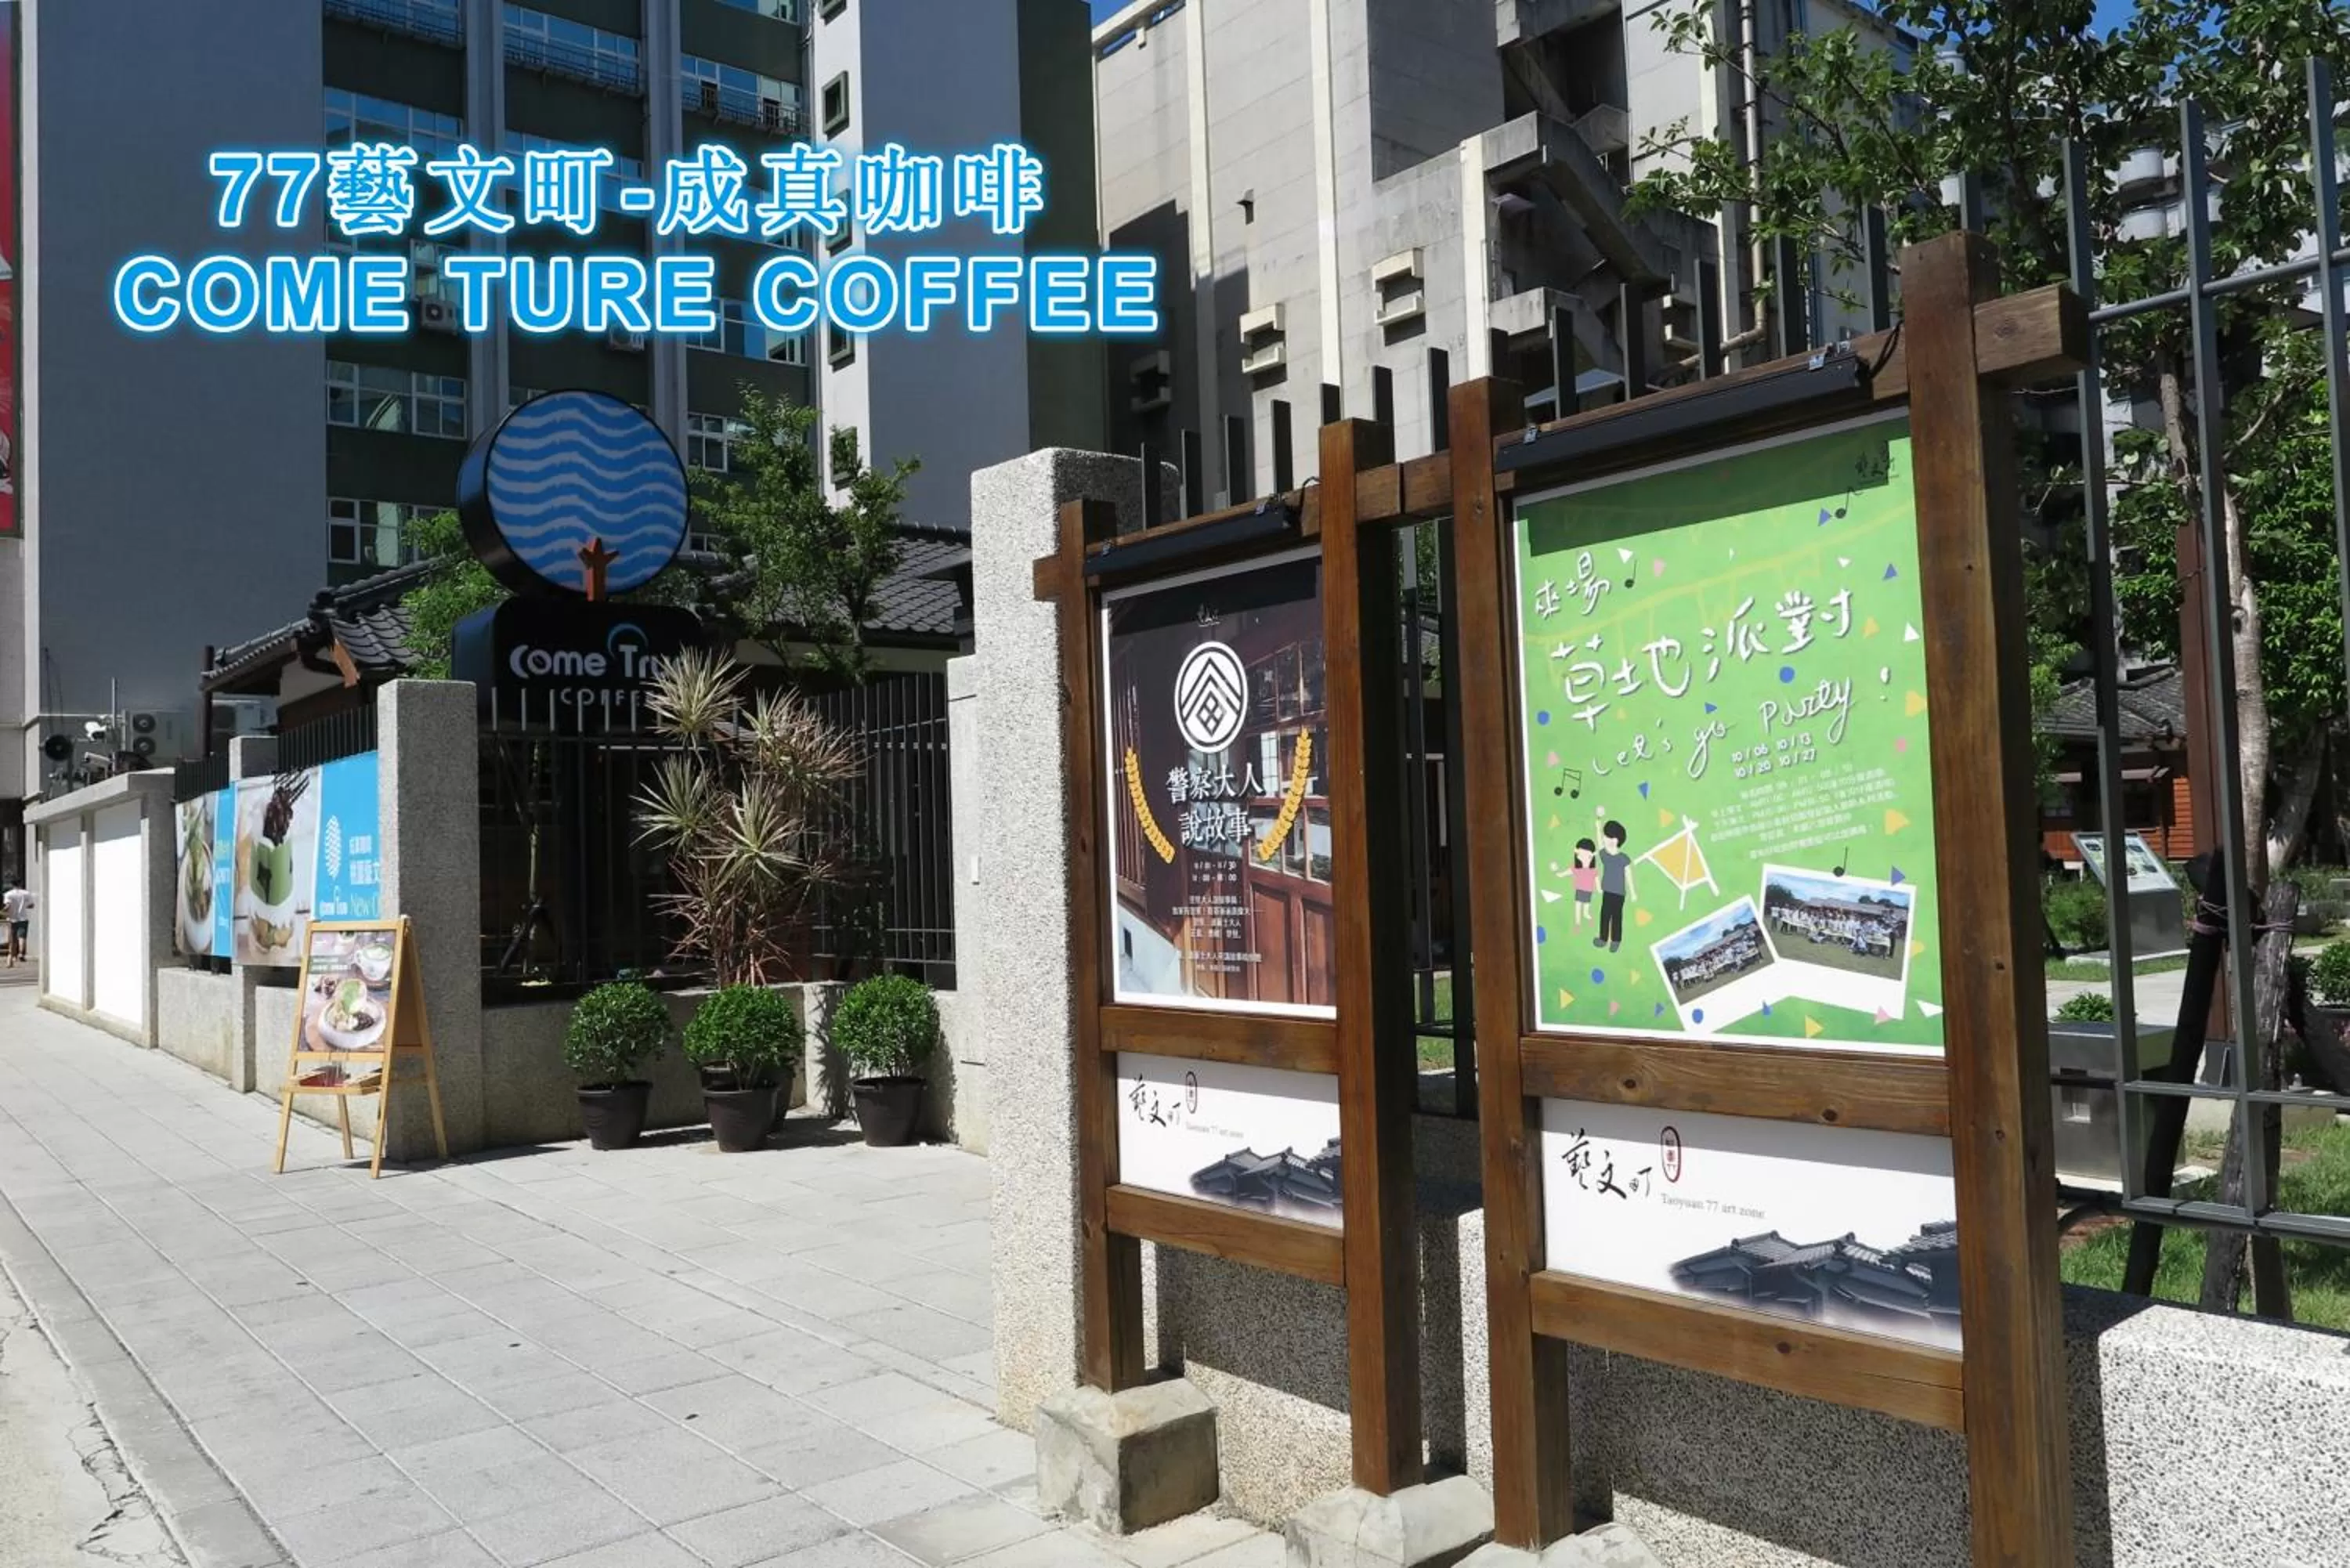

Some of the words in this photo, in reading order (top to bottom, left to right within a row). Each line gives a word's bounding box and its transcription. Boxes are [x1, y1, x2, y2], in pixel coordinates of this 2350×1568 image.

[509, 644, 607, 679] Come
[1549, 587, 1852, 732] 草地派對
[1166, 762, 1264, 804] 警察大人
[1177, 807, 1252, 846] 說故事
